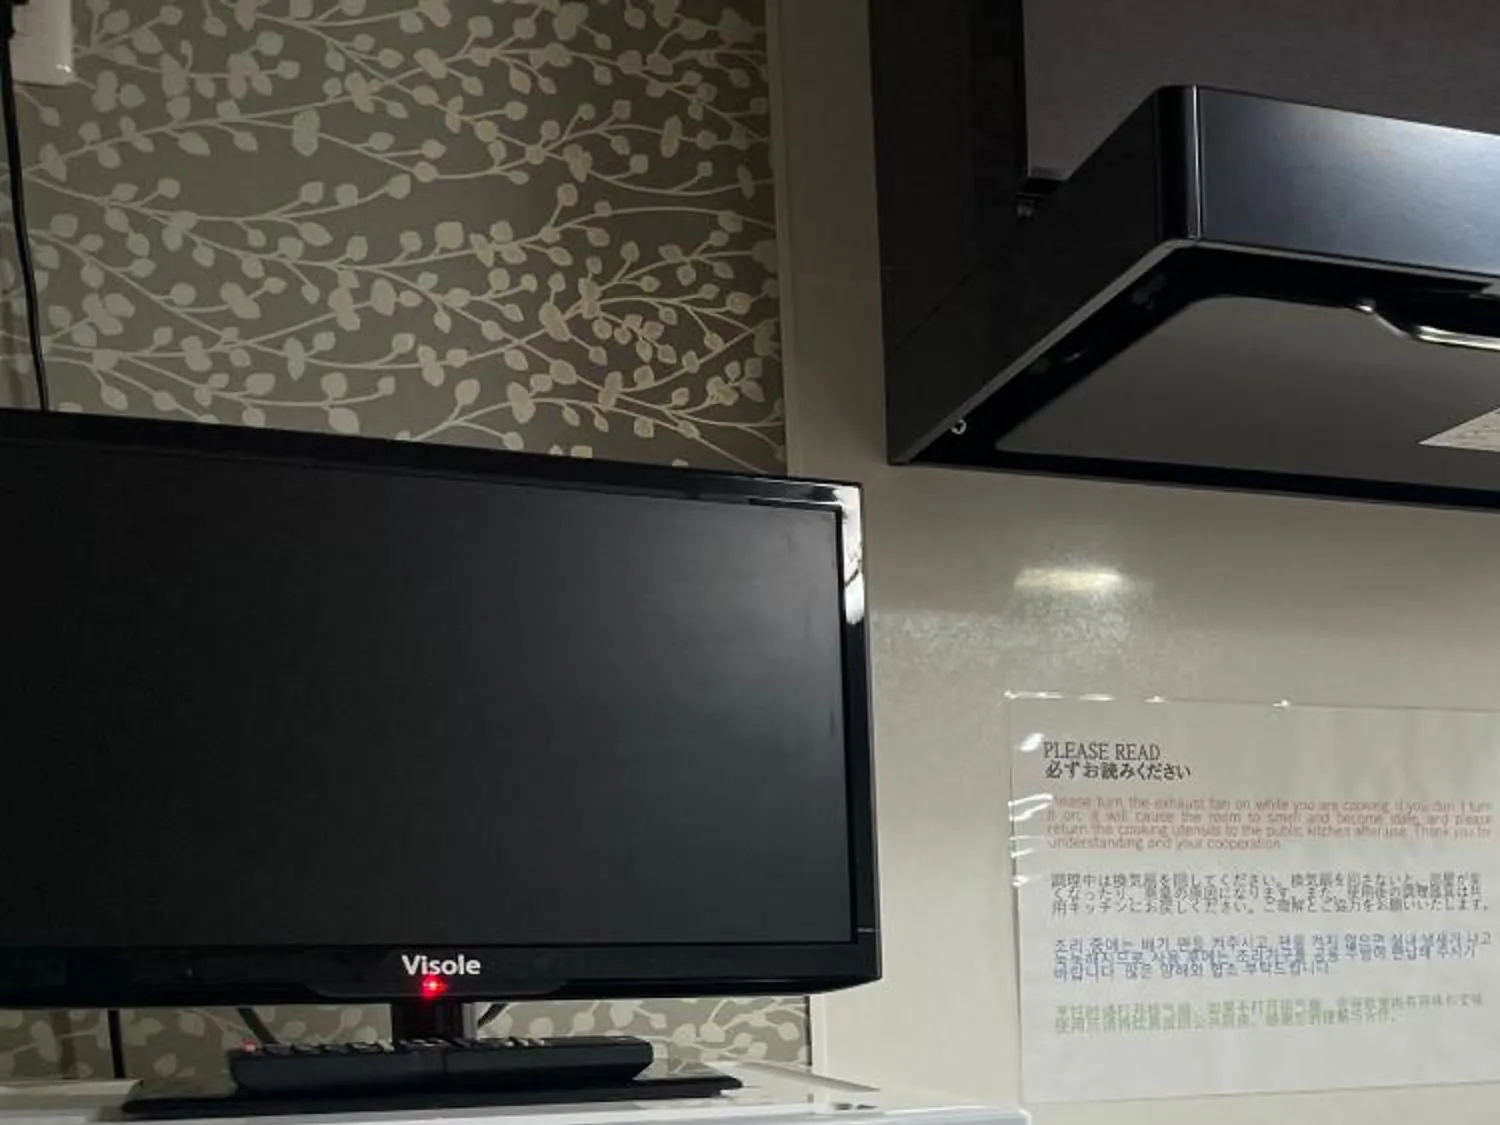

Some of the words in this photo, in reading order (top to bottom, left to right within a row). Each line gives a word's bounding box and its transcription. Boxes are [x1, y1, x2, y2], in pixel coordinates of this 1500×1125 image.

[1043, 741, 1109, 760] PLEASE
[1114, 743, 1161, 761] READ
[1045, 760, 1192, 780] 必ずお読みください
[401, 953, 482, 976] Visole
